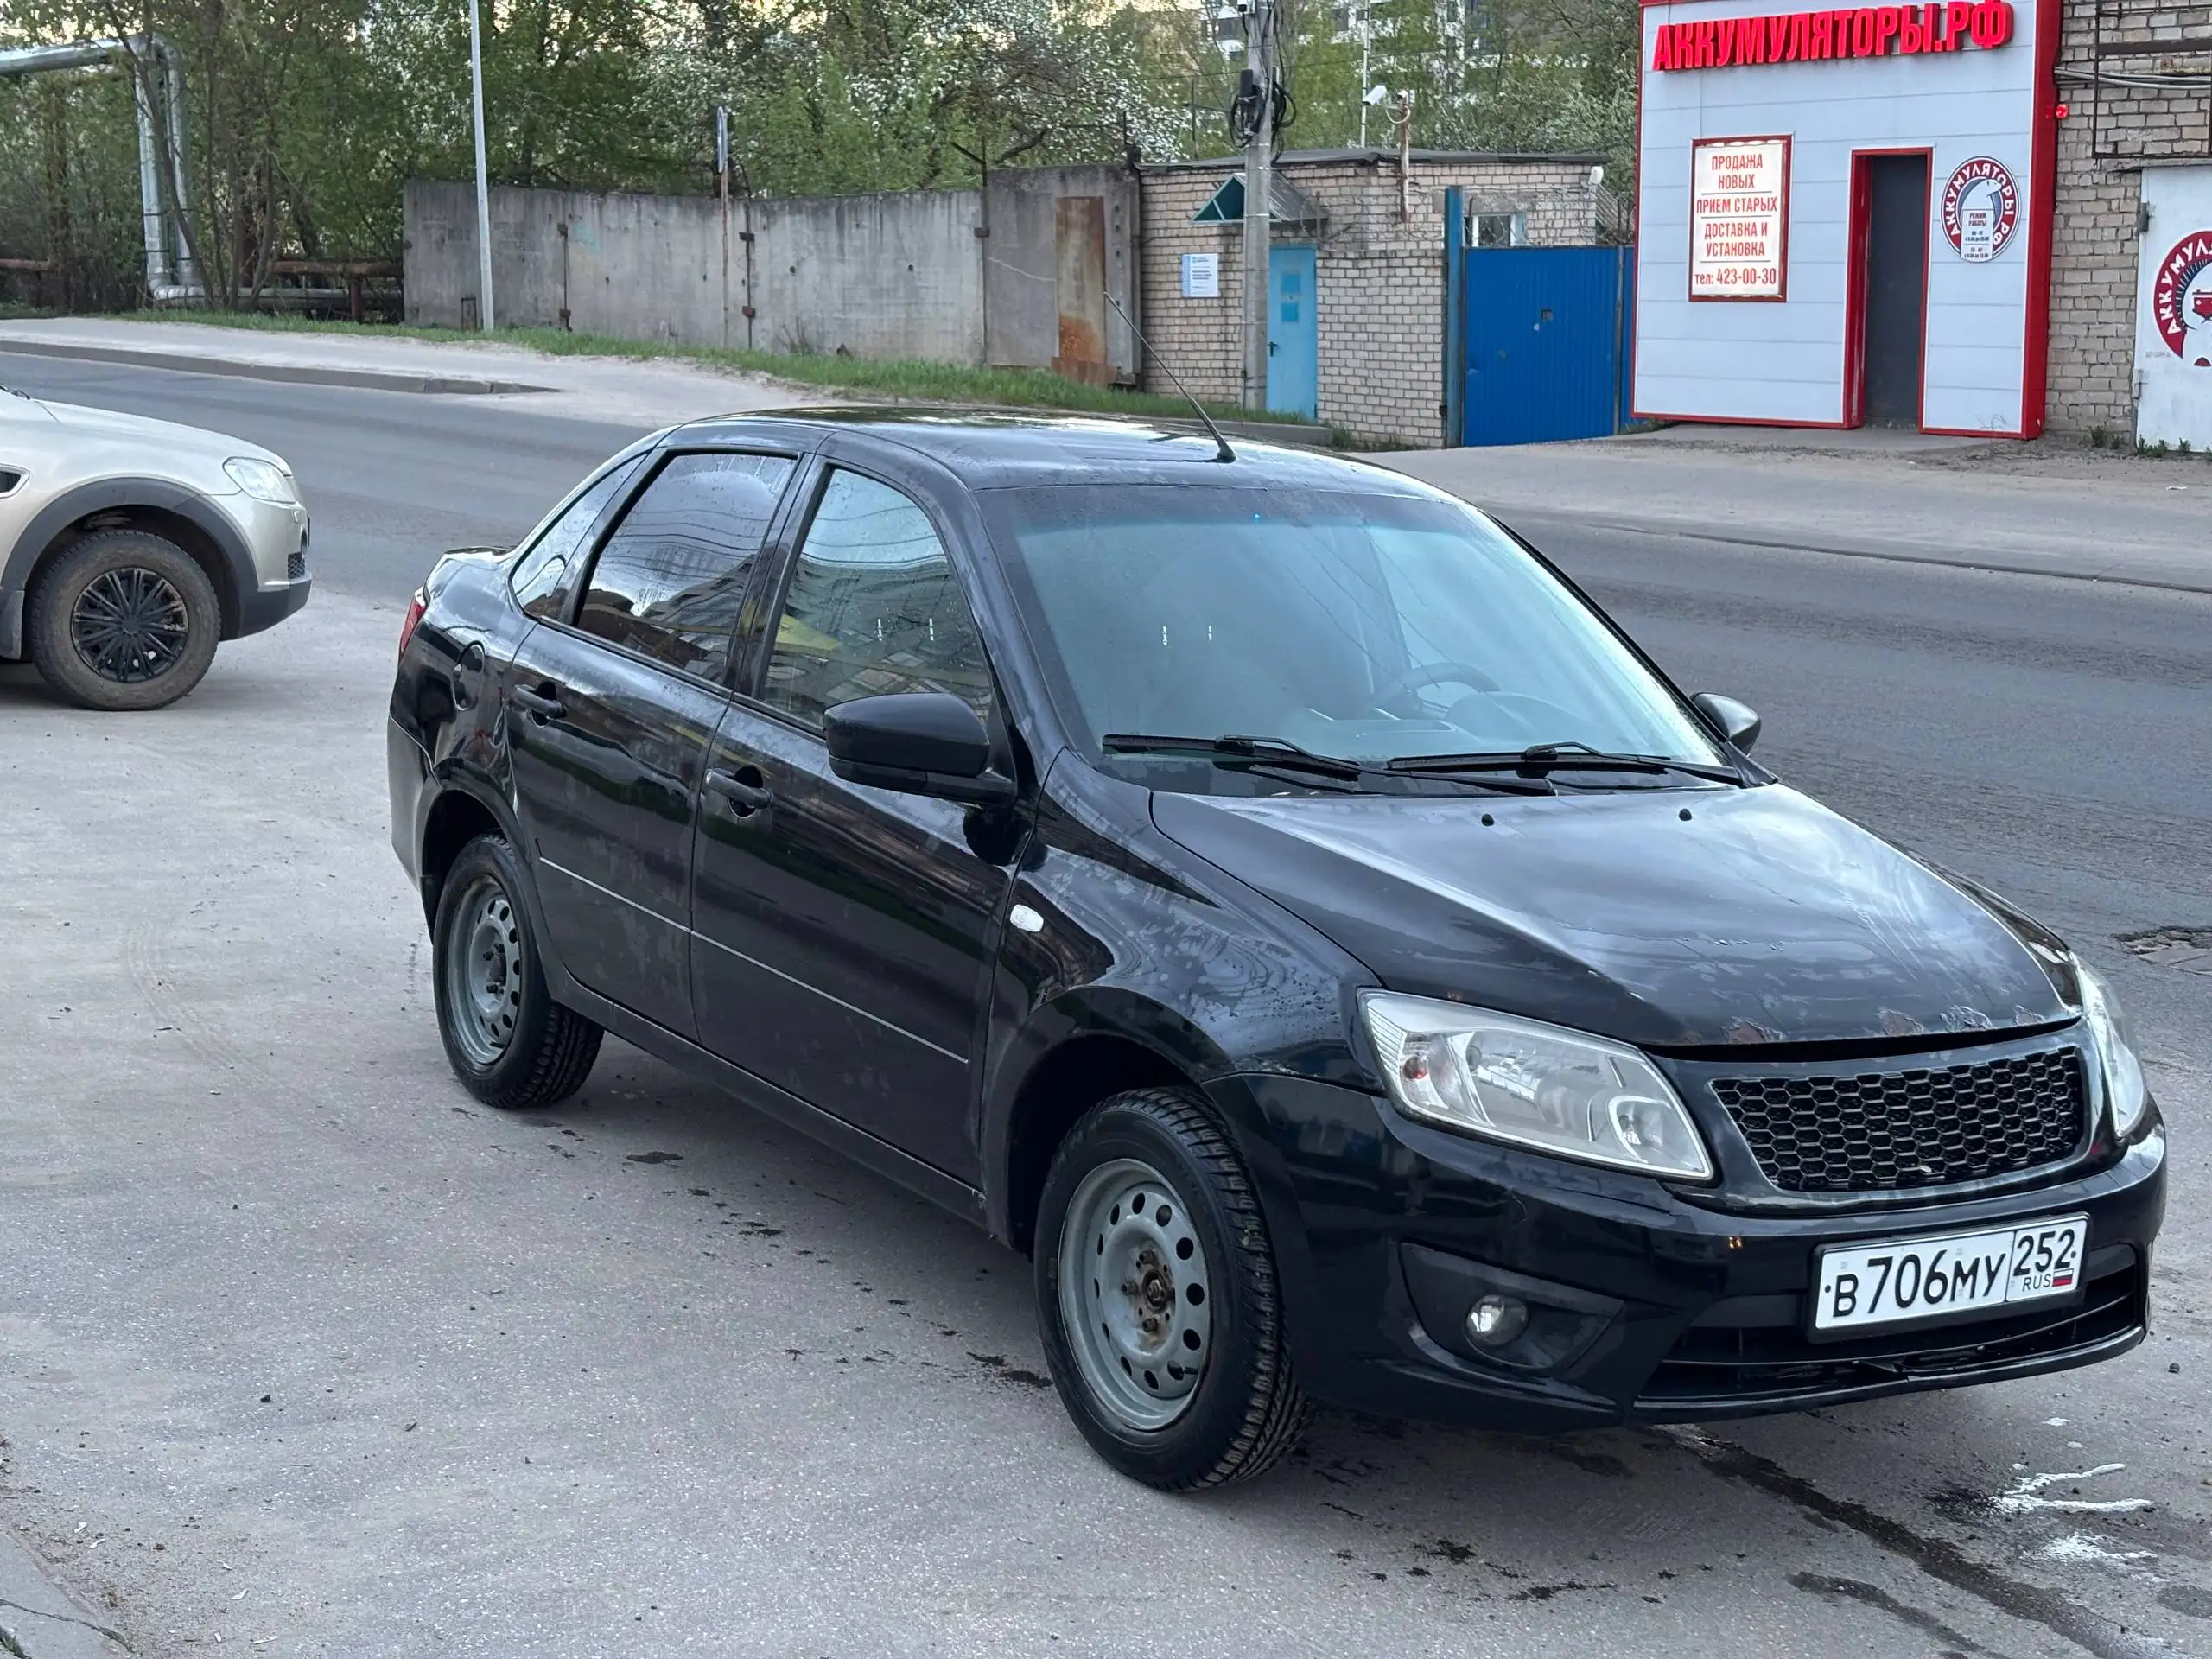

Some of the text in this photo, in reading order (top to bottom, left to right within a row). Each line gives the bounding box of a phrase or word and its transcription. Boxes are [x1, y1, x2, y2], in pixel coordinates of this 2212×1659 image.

[1652, 0, 2013, 71] АККУМУЛЯТОРЫ.РФ
[1712, 154, 1763, 172] ПРОДАЖА
[1718, 174, 1755, 189] НОВЫХ
[1696, 197, 1777, 213] ПРИЕМ СТАРЫХ
[1945, 163, 2014, 236] АККУМУЛЯТОРЫ
[1705, 222, 1768, 240] ДОСТАВКА И
[1707, 242, 1764, 257] УСТАНОВКА
[1694, 268, 1777, 285] тел: 423-00-30
[2158, 238, 2212, 335] АККУМУЛ
[2013, 1229, 2075, 1276] 252
[2022, 1274, 2051, 1293] RUS
